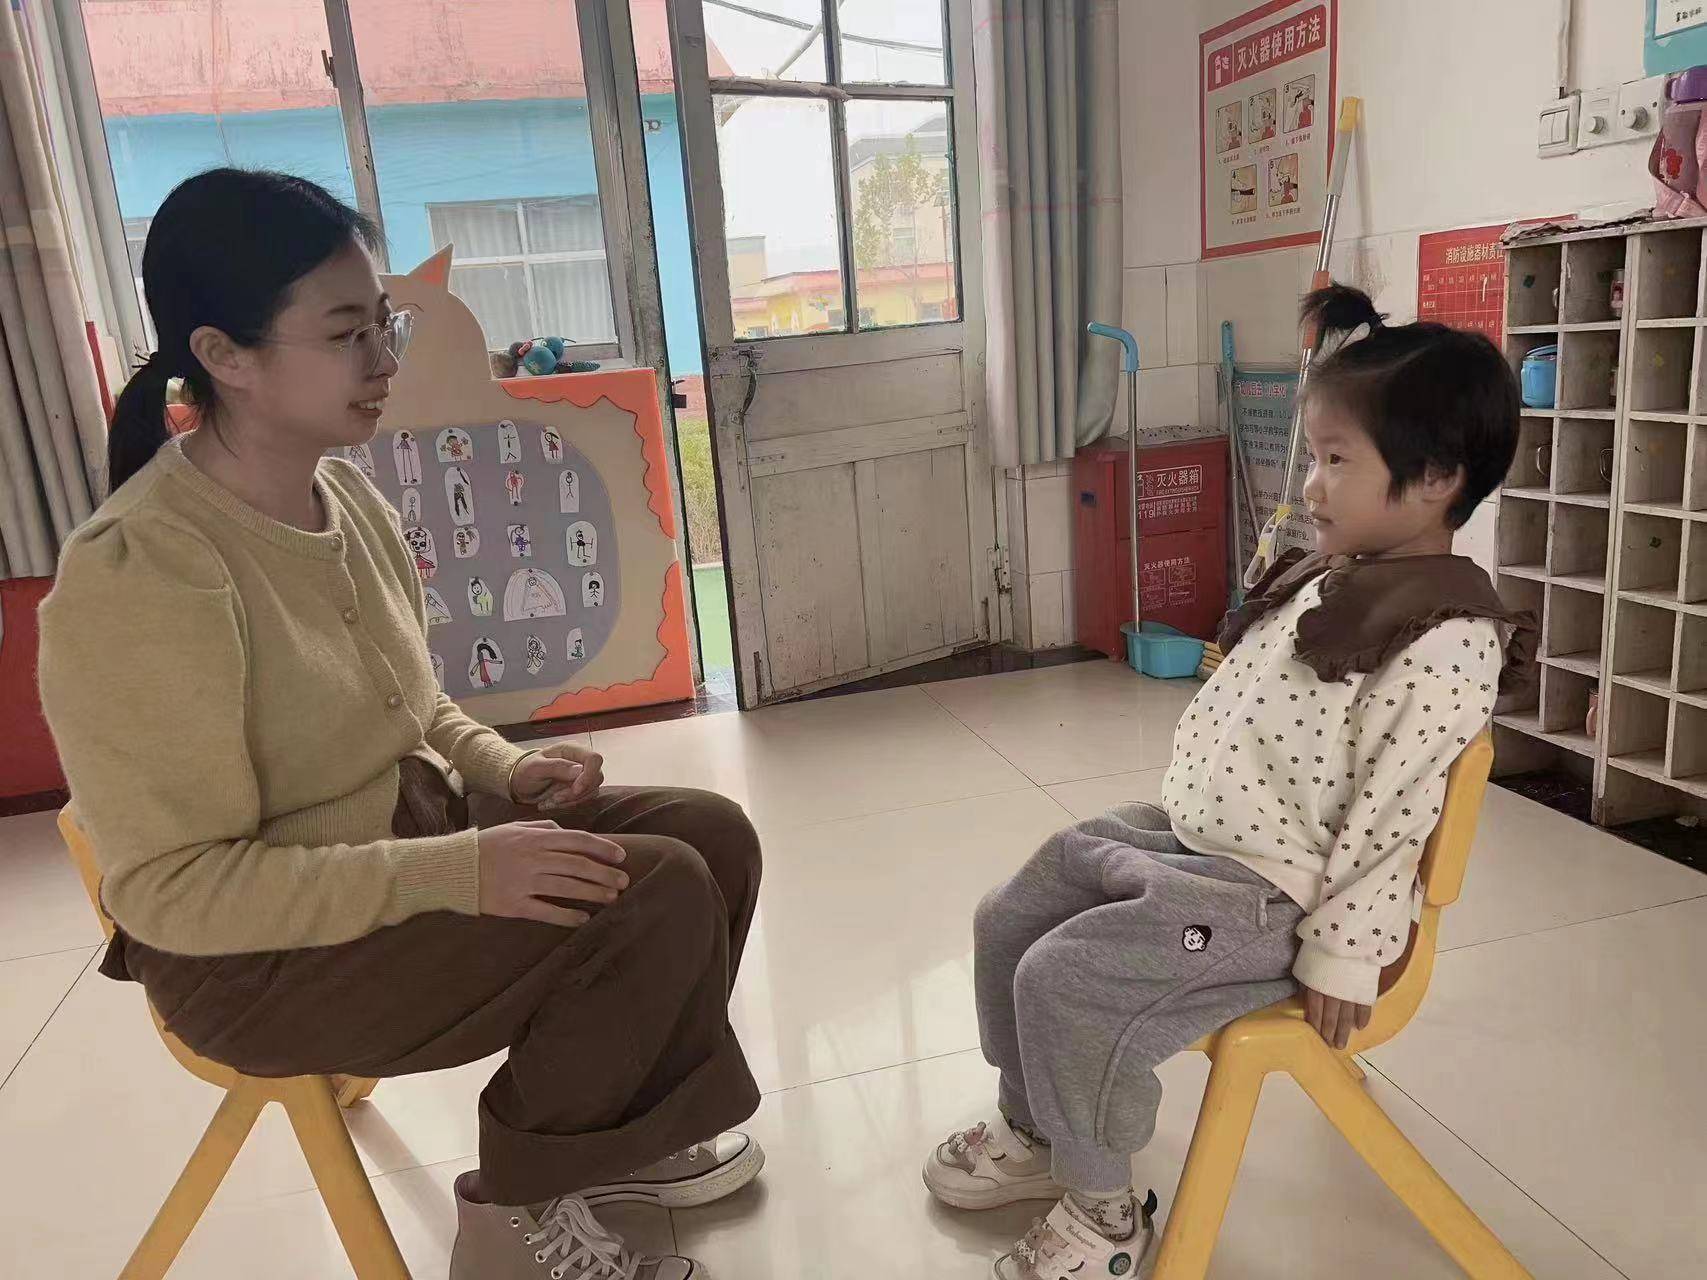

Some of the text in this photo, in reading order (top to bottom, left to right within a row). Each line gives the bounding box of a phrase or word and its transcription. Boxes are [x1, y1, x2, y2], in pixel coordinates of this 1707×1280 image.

[1237, 13, 1321, 73] 灭火器使用方法
[1156, 468, 1199, 488] 灭火器箱
[1138, 509, 1154, 520] 119
